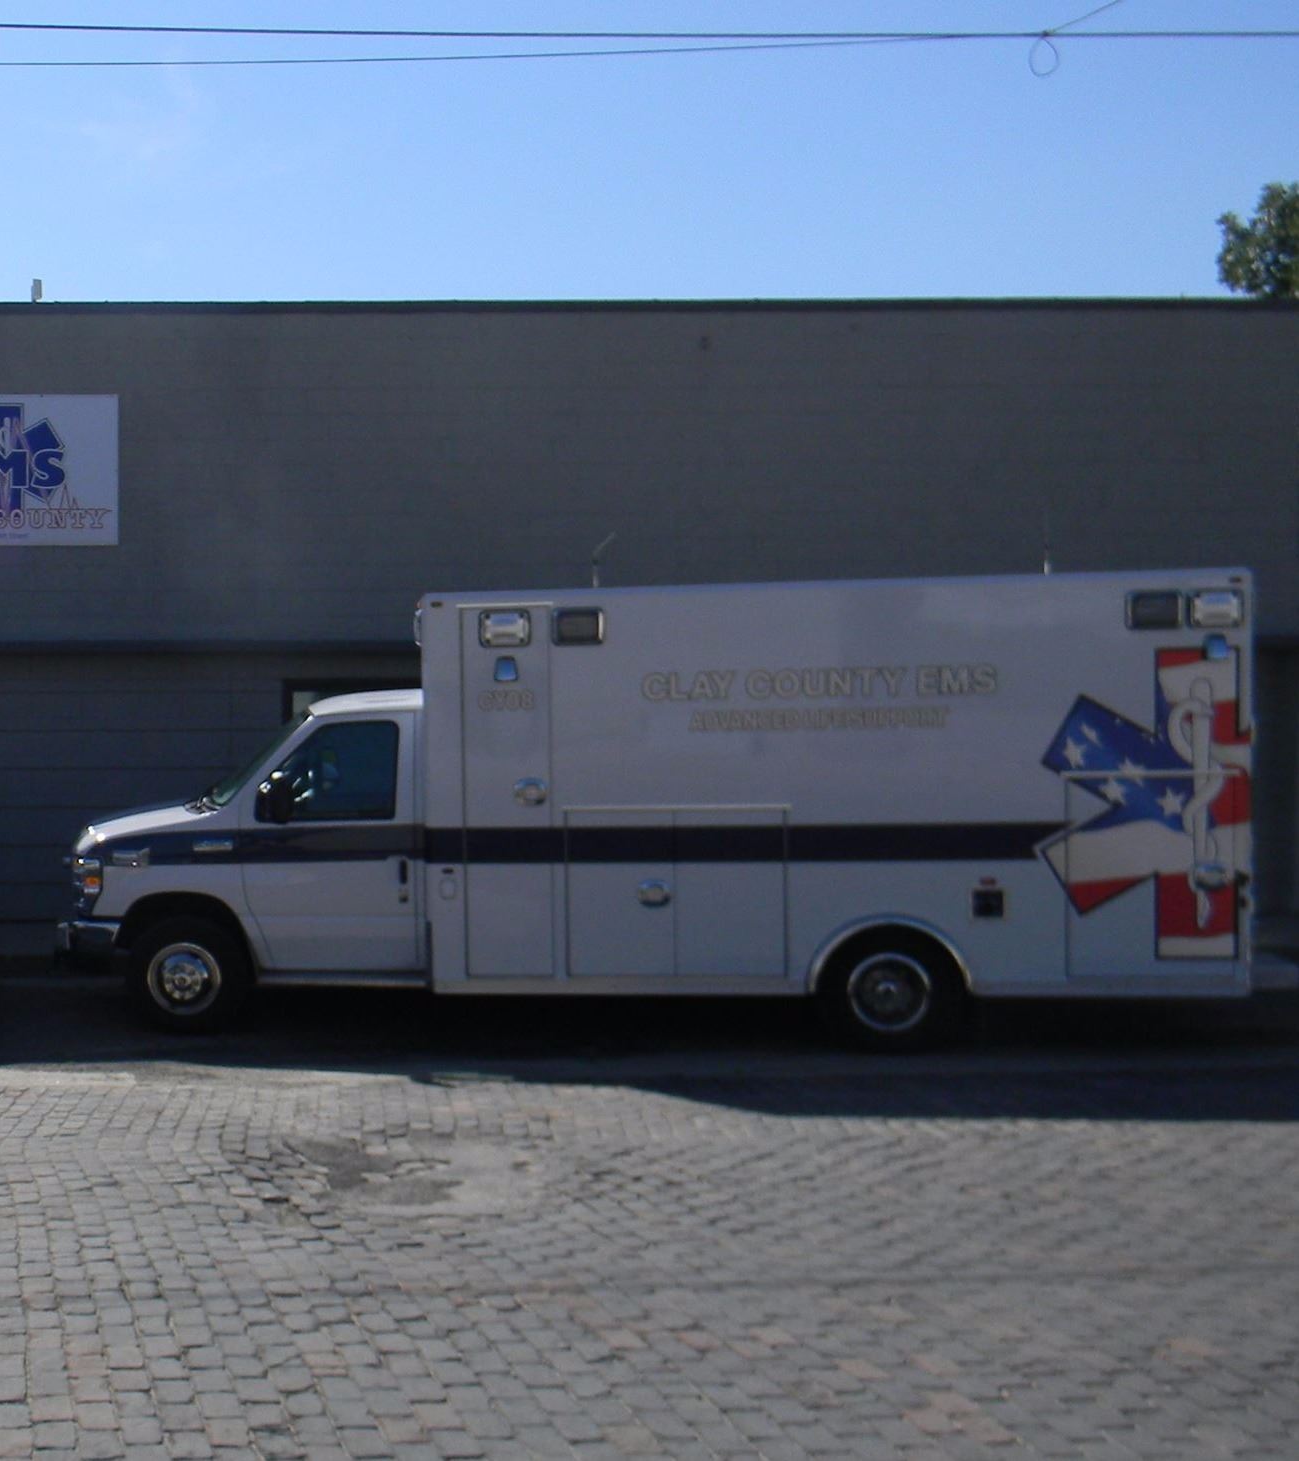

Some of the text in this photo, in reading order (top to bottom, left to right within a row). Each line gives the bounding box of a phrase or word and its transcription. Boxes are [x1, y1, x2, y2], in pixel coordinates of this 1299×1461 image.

[642, 663, 998, 701] CLAY COUNTY EMS
[688, 708, 799, 732] ADVANCED
